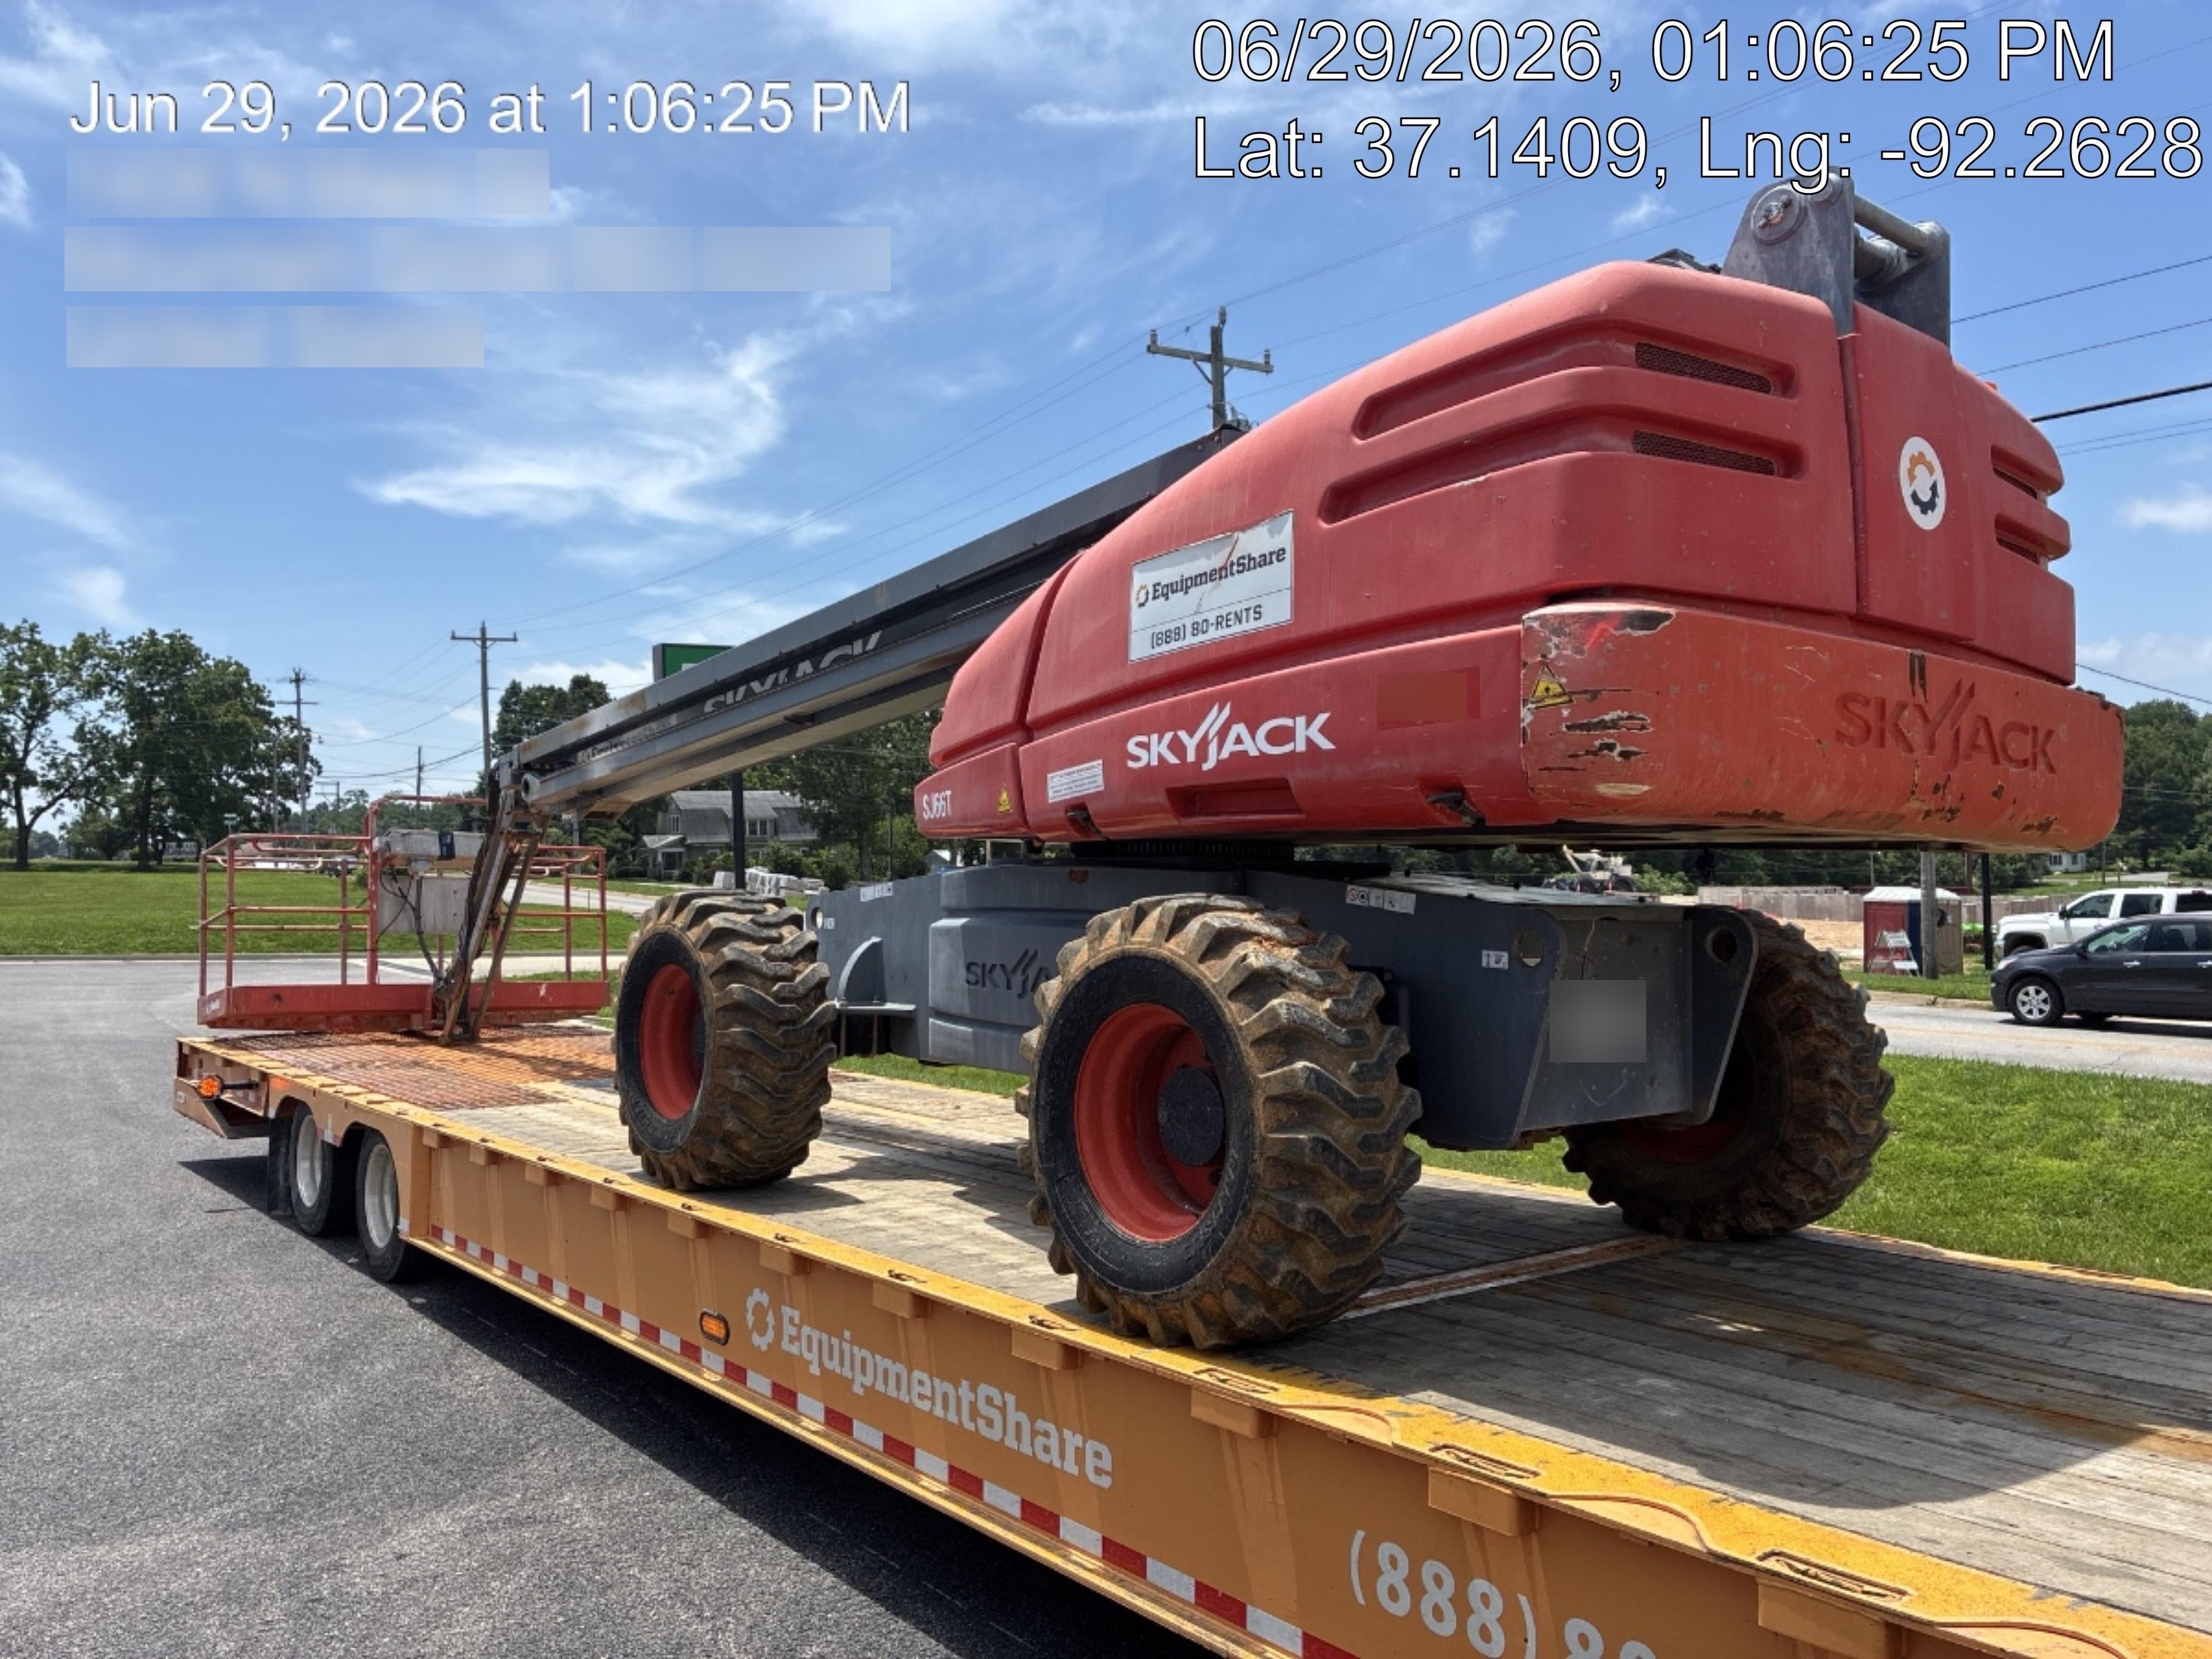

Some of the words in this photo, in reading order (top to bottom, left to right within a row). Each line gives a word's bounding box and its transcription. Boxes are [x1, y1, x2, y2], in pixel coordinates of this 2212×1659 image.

[1152, 547, 1286, 601] EquipmentShare
[1151, 623, 1186, 649] (888)
[1126, 700, 1337, 772] SKYJACK
[1835, 678, 2056, 774] SKYJACK
[923, 790, 952, 820] SJ66T
[781, 1304, 1113, 1489] EquipmentShare
[1351, 1529, 1536, 1659] (888)
